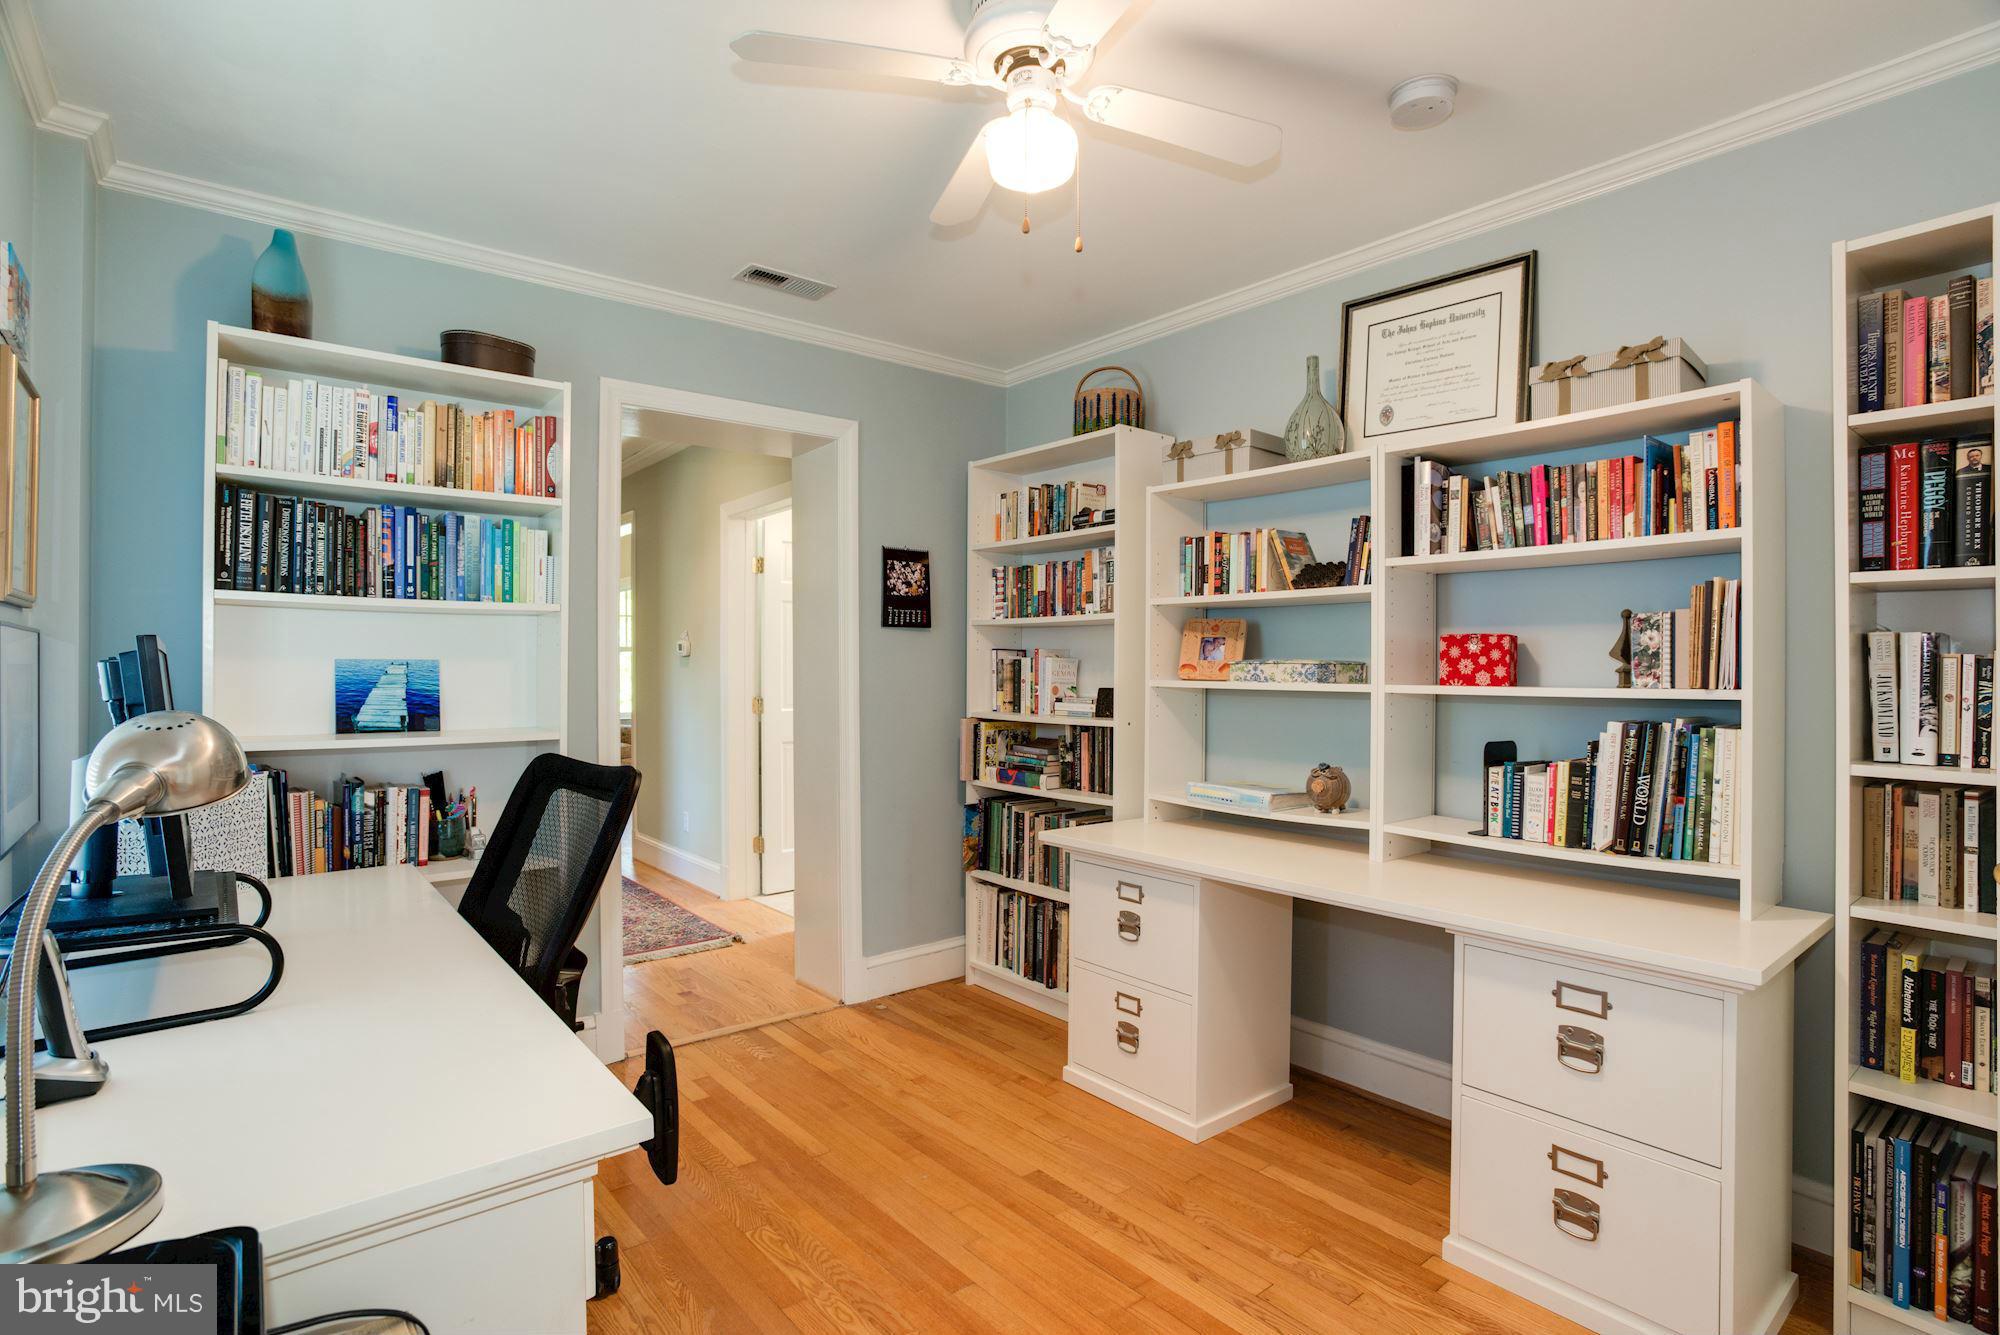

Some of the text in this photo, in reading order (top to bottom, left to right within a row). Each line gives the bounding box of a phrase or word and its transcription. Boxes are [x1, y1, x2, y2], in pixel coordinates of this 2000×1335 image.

[1381, 307, 1486, 339] The Johns Hopkins University
[1868, 368, 1877, 401] COUNTRY
[1888, 355, 1896, 395] BALLARD
[1894, 448, 1915, 460] Me
[1924, 469, 1946, 510] PEGGY
[240, 499, 253, 521] FIFTH
[281, 508, 291, 534] DIFFUSION
[1900, 464, 1912, 555] Katharine Hepburn
[239, 522, 252, 562] DISCIPLINE
[261, 520, 269, 565] ORGANIZATION
[280, 543, 289, 576] INNOVATIONS
[1876, 674, 1894, 737] JACKSONLAND
[1606, 777, 1614, 789] FOR
[1632, 774, 1651, 826] WORLD
[1491, 802, 1499, 823] BOOK
[1602, 790, 1613, 823] CHILDREN
[364, 814, 374, 849] MIDDLESEX
[1903, 975, 1914, 1023] Alzheimer's
[1868, 1010, 1877, 1027] Flight
[1929, 1000, 1938, 1049] THE BOOK THIEF
[1903, 1035, 1913, 1073] DUMMIES
[1853, 1176, 1862, 1214] BIG BANG
[1981, 1193, 1992, 1218] Rockets
[1979, 1235, 1992, 1256] People
